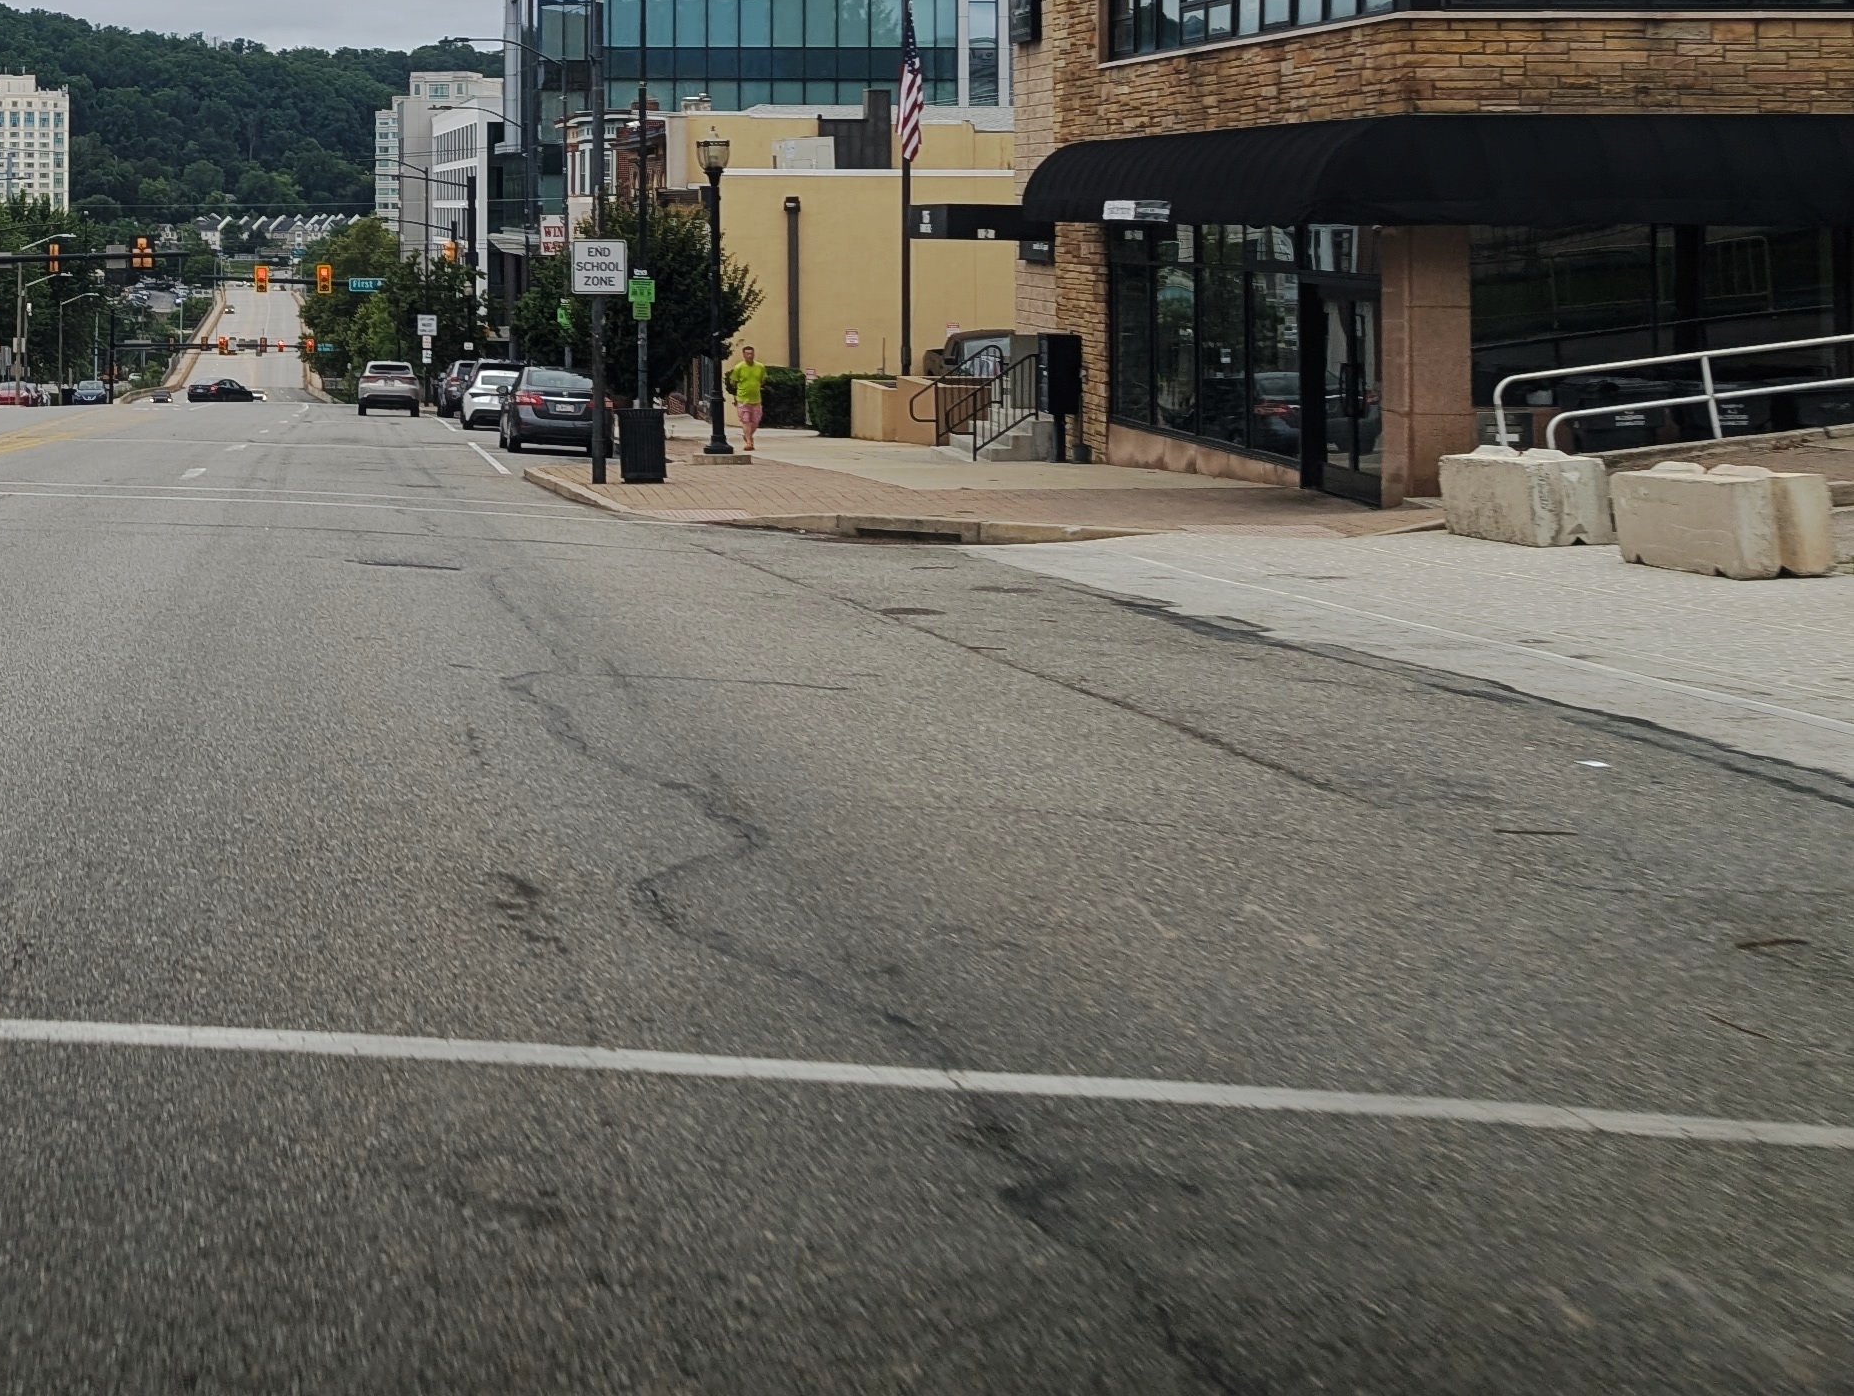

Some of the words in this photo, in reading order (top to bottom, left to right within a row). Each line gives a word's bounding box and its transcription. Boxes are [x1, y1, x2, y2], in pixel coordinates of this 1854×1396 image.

[587, 246, 611, 257] END
[575, 261, 624, 272] SCHOOL
[352, 279, 373, 288] First
[583, 275, 616, 287] ZONE
